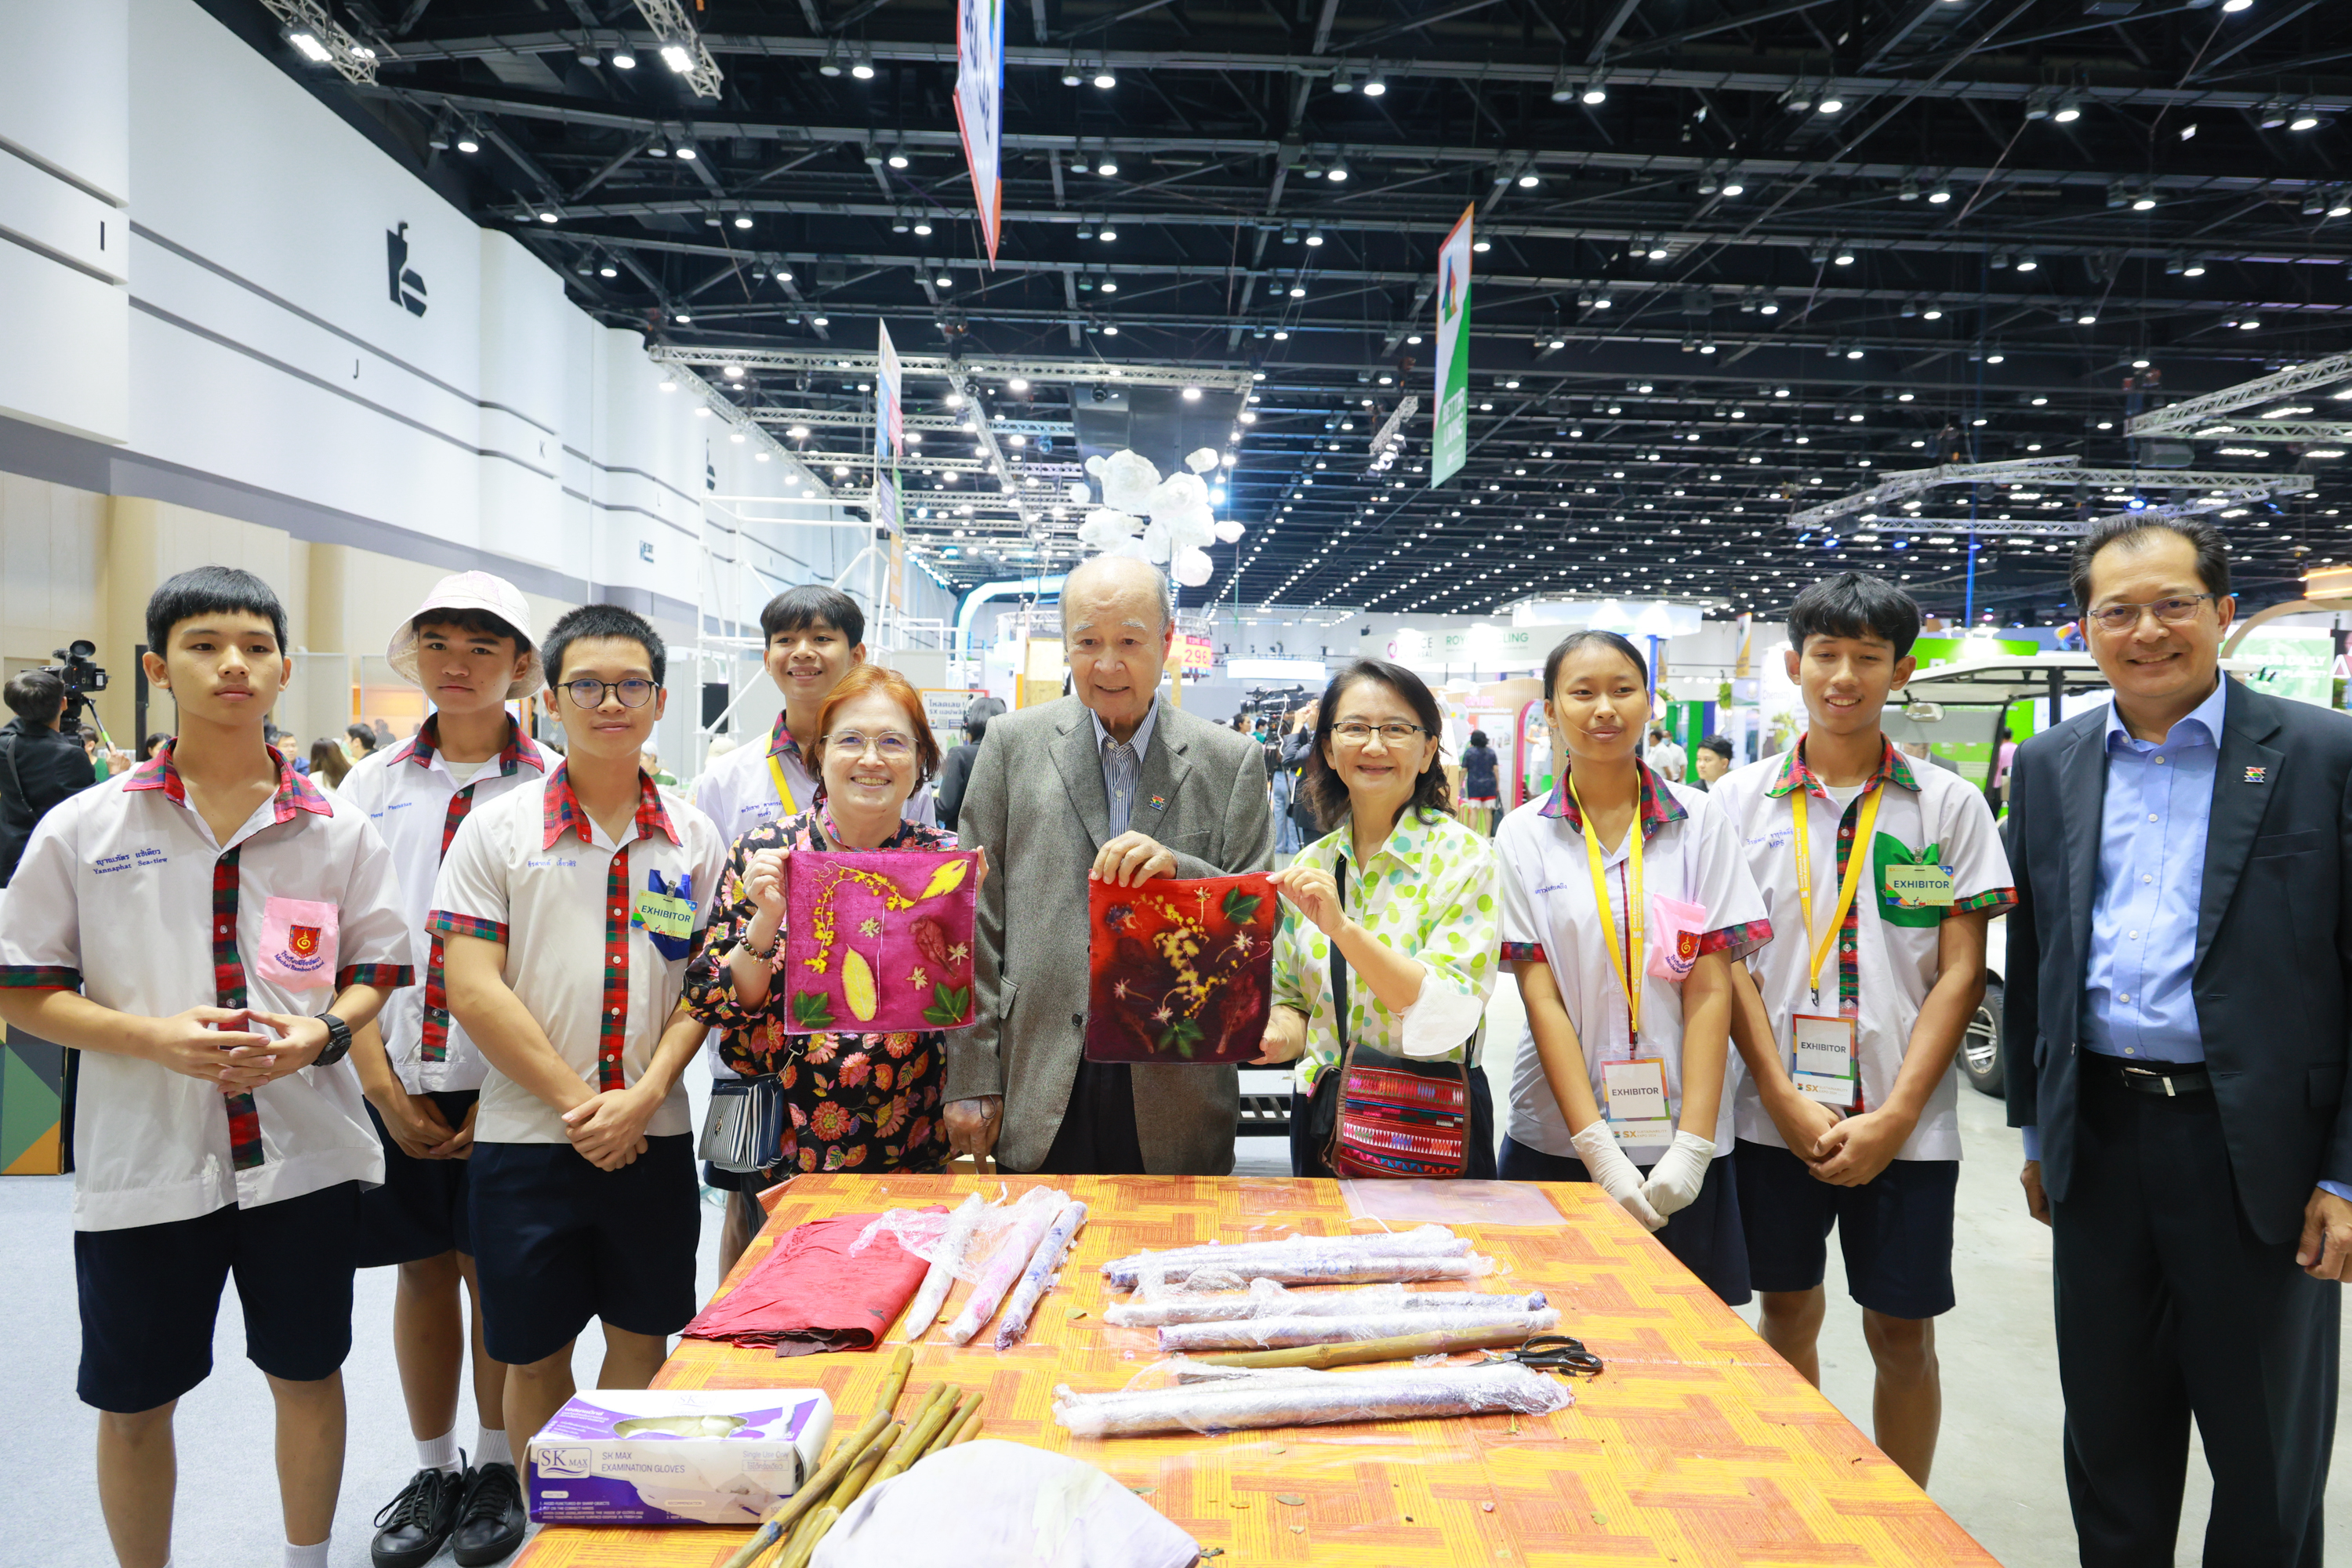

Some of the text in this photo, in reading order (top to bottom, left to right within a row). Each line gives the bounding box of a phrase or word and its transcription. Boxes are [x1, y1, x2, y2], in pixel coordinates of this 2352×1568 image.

[1769, 840, 1784, 848] MPS
[93, 858, 168, 874] Yannaphat Sea-tiew
[1893, 880, 1950, 888] EXHIBITOR
[641, 905, 691, 923] EXHIBITOR
[311, 960, 325, 971] School
[1801, 1041, 1846, 1053] EXHIBITOR
[1612, 1087, 1659, 1096] EXHIBITOR
[541, 1450, 566, 1466] SK
[742, 1450, 761, 1459] Single
[601, 1464, 685, 1473] EXAMINATION GLOVES
